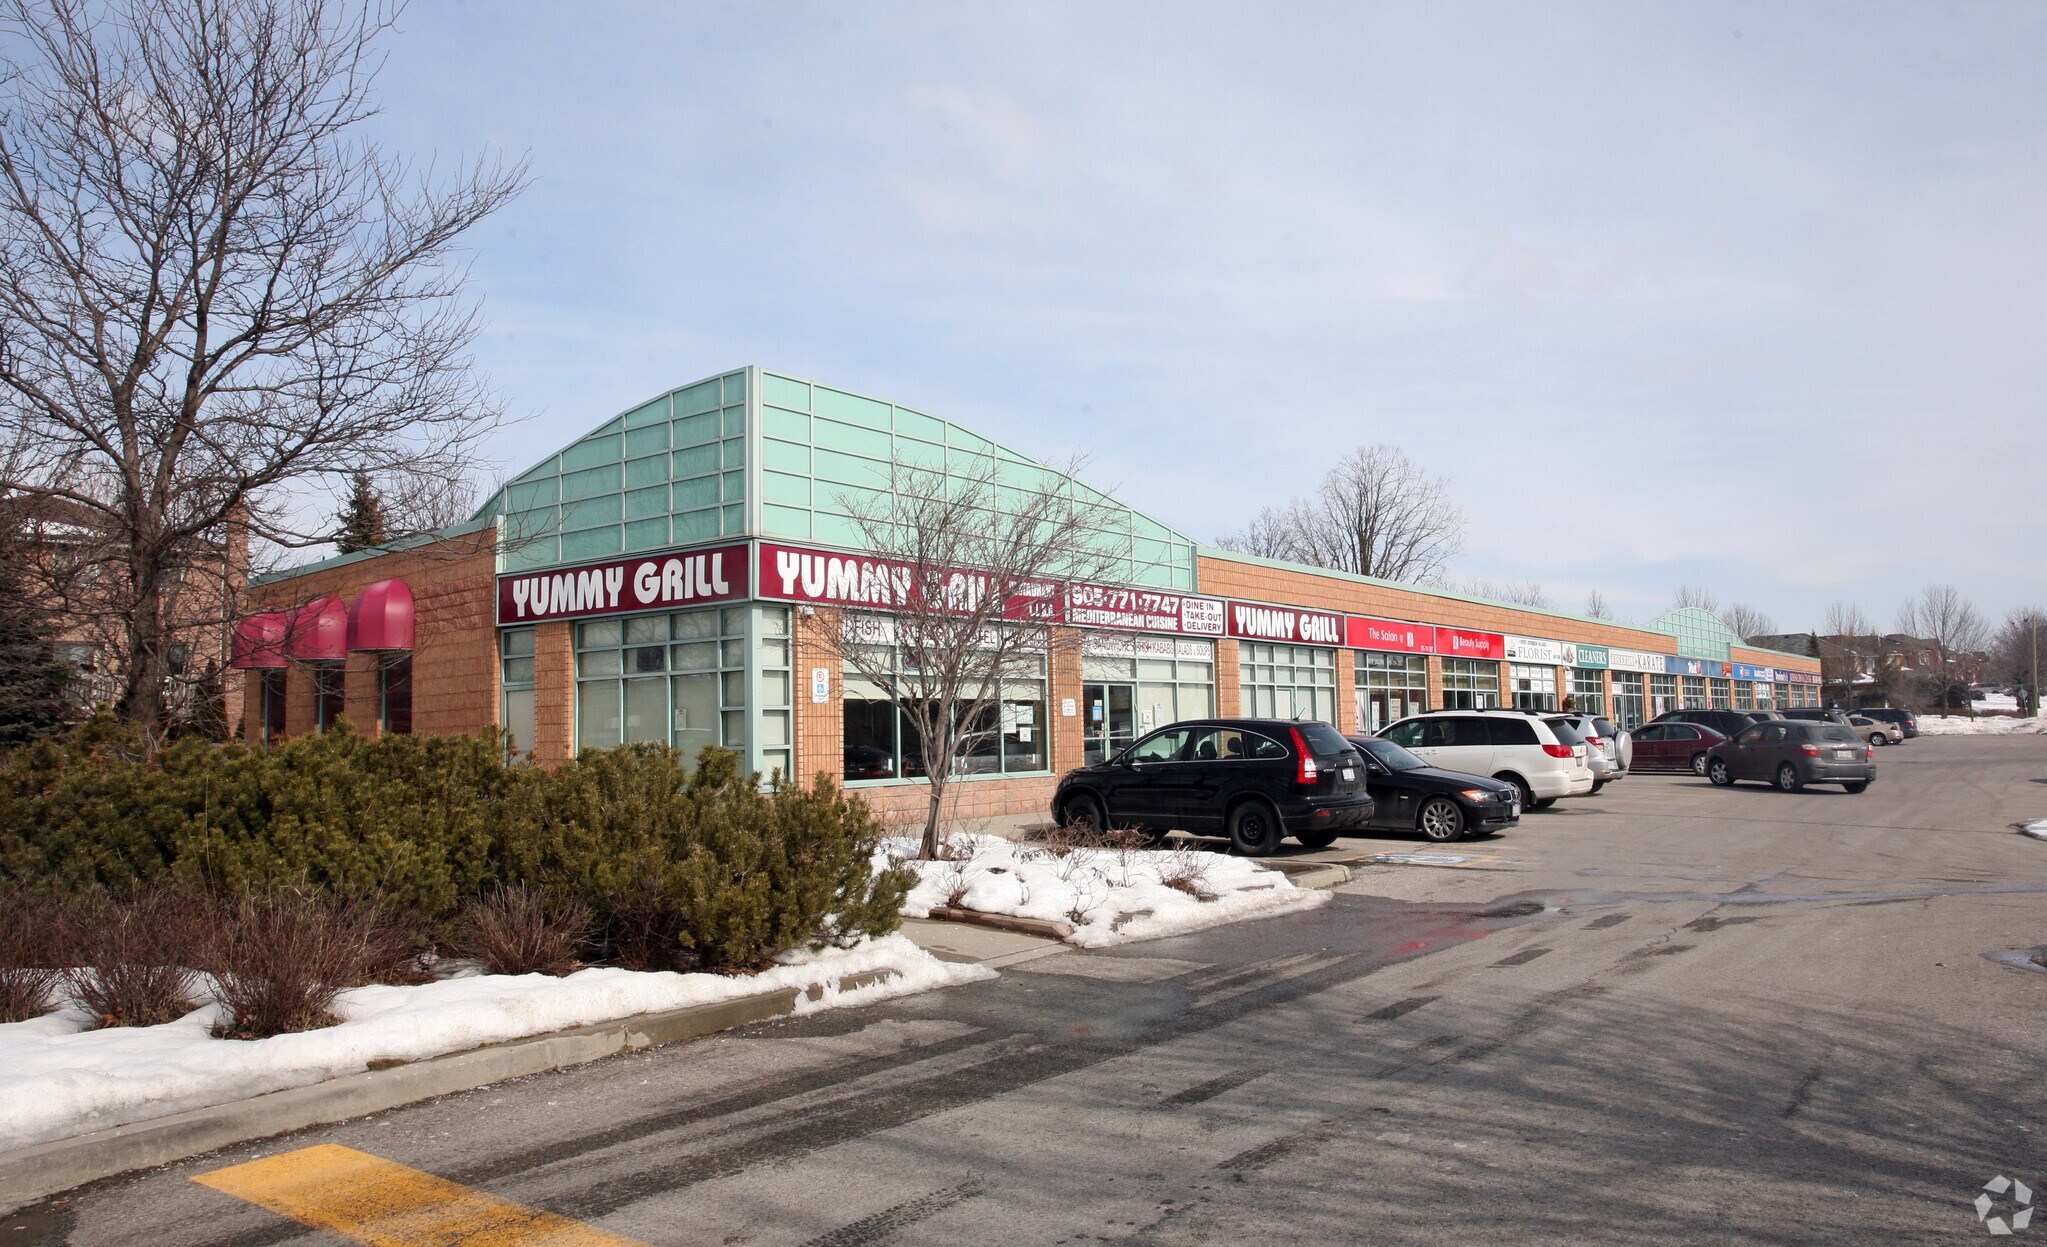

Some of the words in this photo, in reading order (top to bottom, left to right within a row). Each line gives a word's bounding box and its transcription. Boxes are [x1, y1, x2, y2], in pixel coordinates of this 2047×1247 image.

[512, 566, 624, 617] YUMMY
[633, 552, 729, 604] GRILL
[776, 550, 912, 606] YUMMY
[1186, 601, 1204, 611] DINE
[1206, 602, 1214, 611] IN
[1072, 608, 1145, 627] MEDITERRANEAN
[1146, 615, 1178, 631] CUISINE
[1186, 611, 1222, 622] TAKE-OUT
[1235, 605, 1295, 639] YUMMY
[1299, 614, 1339, 642] GRILL
[854, 619, 881, 636] FISH
[1187, 621, 1221, 631] DELIVERY
[1368, 627, 1380, 639] The
[1381, 630, 1398, 642] Salon
[1460, 636, 1475, 649] Beauty
[1475, 638, 1490, 651] Supply
[1518, 646, 1552, 661] FLORIST
[1578, 649, 1607, 664] CLEANERS
[1637, 655, 1663, 671] KARATE
